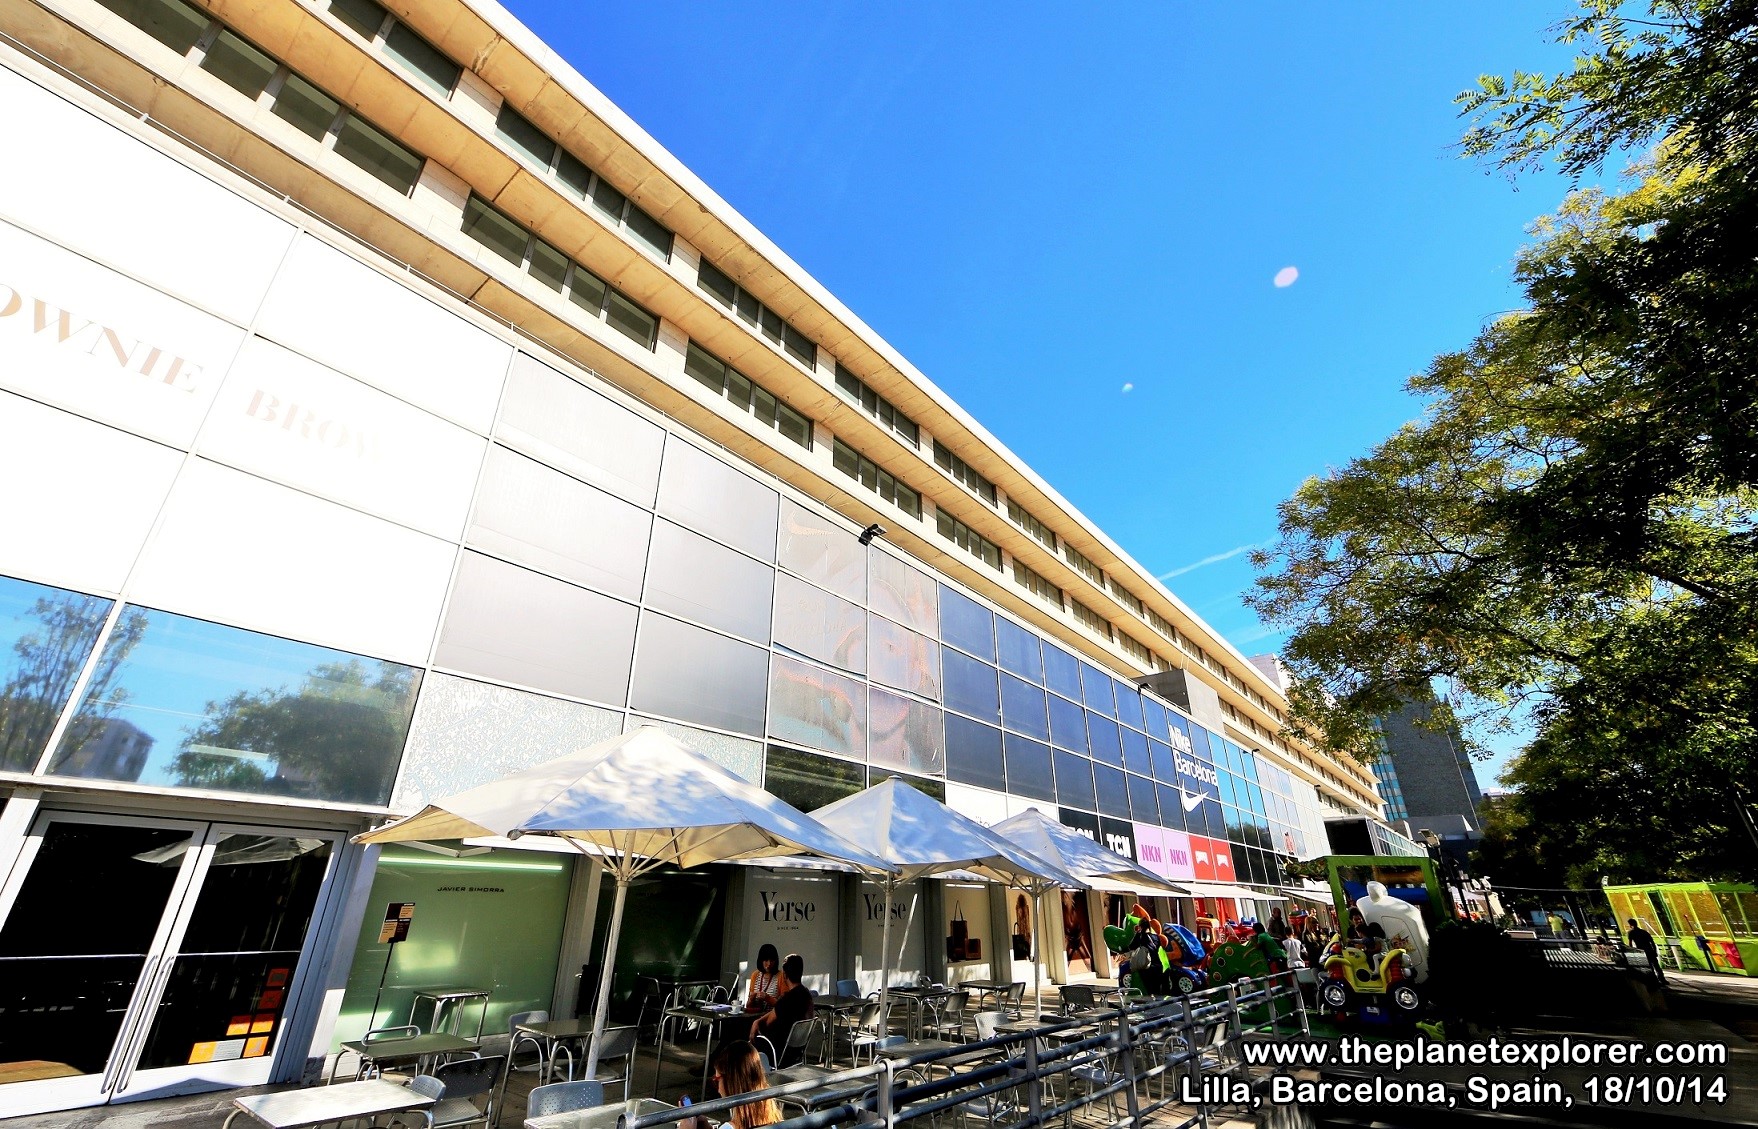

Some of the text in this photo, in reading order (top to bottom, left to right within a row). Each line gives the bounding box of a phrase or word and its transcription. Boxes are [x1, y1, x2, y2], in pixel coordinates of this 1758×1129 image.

[1169, 724, 1192, 754] Nike
[1173, 748, 1218, 787] Barcelona
[1106, 833, 1132, 858] TCN
[1141, 844, 1162, 863] NKN
[1169, 848, 1188, 866] NKN
[759, 891, 816, 922] Yerse
